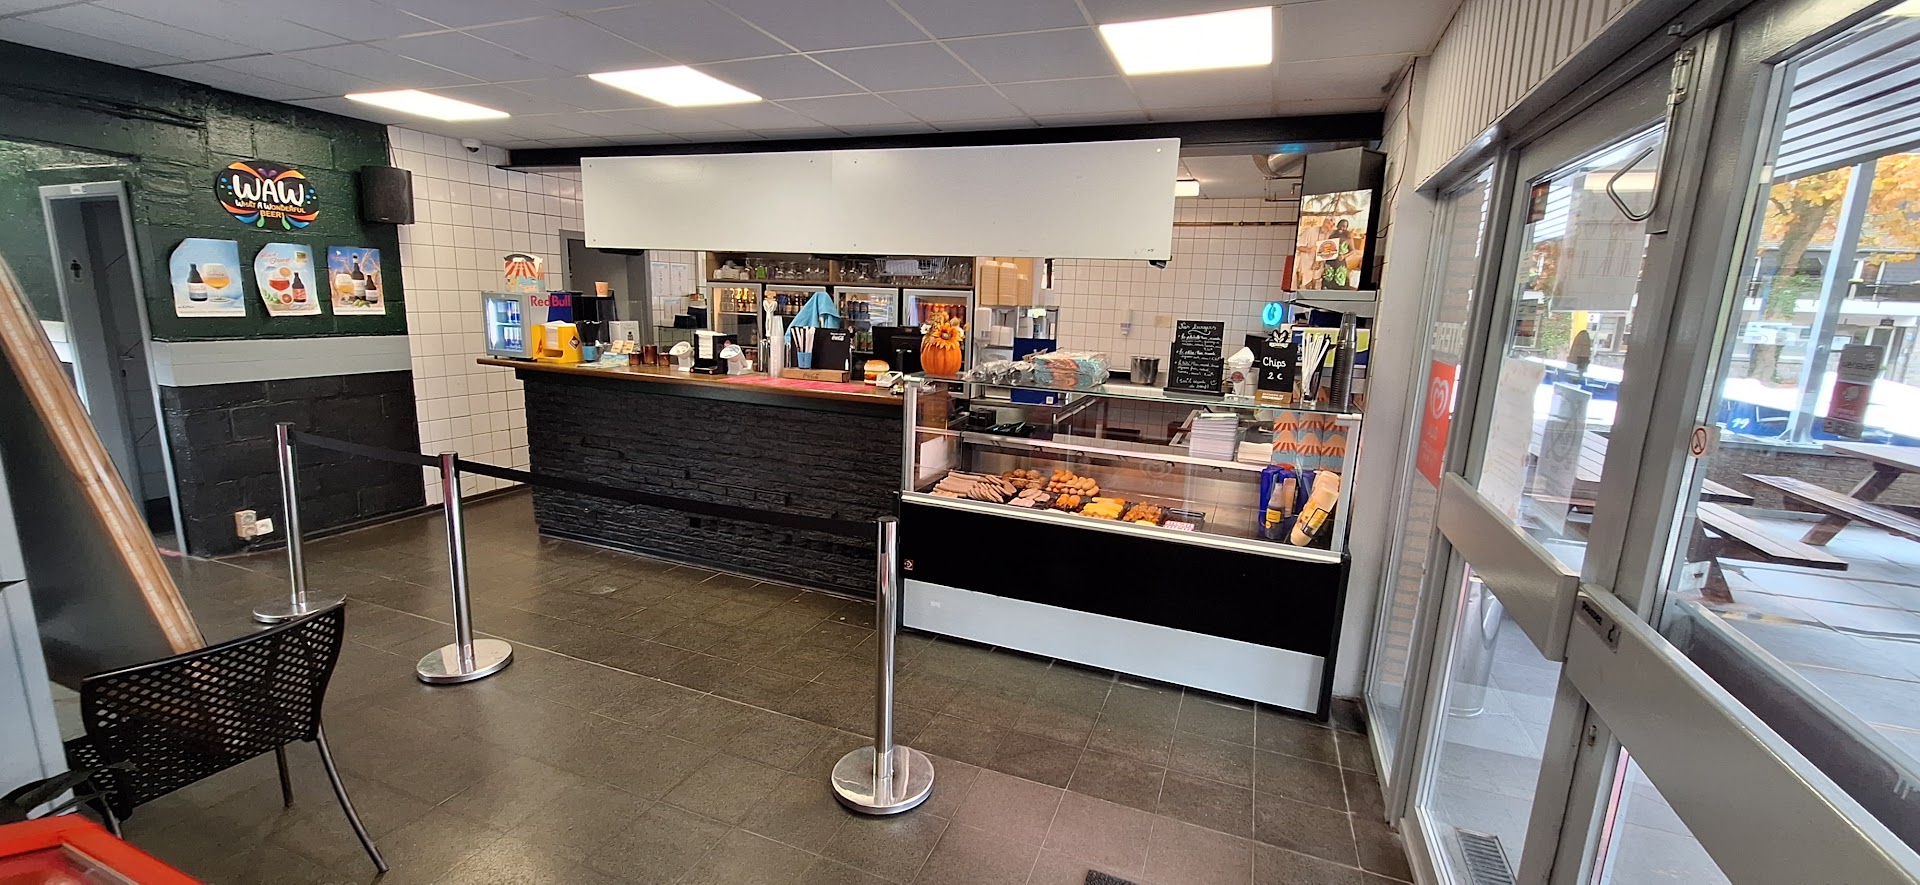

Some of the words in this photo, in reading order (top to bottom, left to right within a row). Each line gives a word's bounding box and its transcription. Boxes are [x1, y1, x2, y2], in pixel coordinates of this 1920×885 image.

[232, 174, 304, 206] WAW
[257, 201, 263, 210] A
[263, 202, 307, 214] WONDERFUL
[1262, 356, 1287, 370] Chips
[1267, 371, 1275, 380] 2
